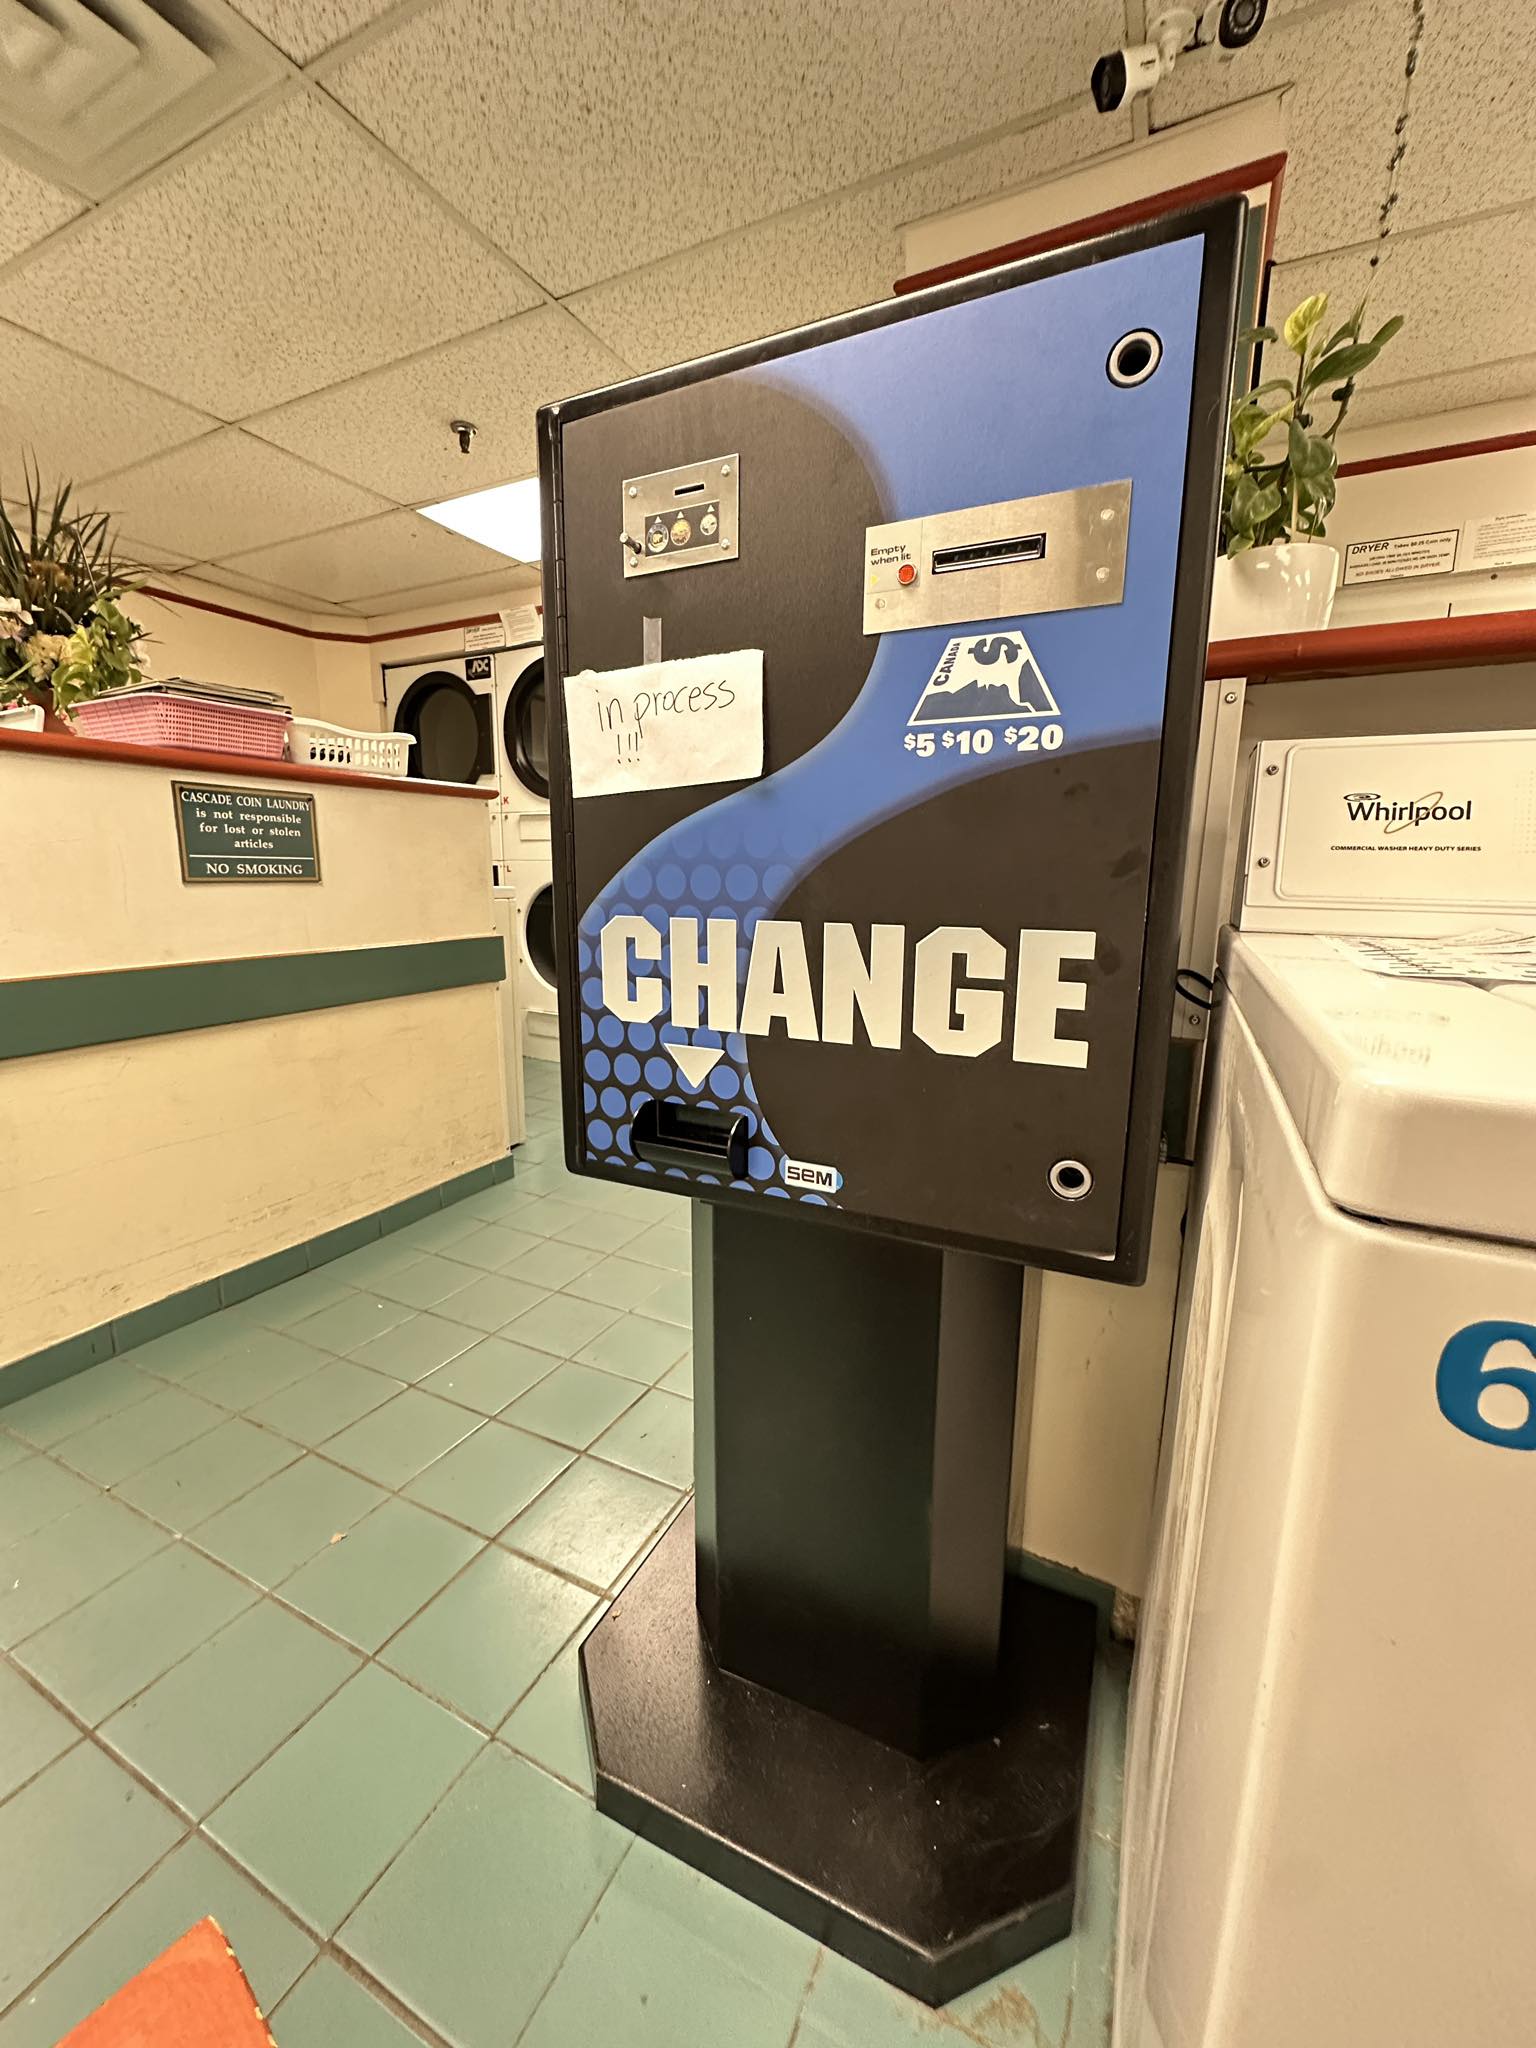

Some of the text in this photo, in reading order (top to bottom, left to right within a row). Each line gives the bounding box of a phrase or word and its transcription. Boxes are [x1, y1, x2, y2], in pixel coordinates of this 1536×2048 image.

[870, 544, 906, 556] Empty
[1351, 542, 1390, 555] DRYER
[870, 553, 912, 566] when lit
[933, 641, 961, 686] CANADA
[633, 680, 736, 739] process
[903, 724, 1064, 758] $5 $10 $20
[181, 791, 311, 812] CASCADE COIN LAUNDRY
[196, 808, 302, 824] is not responsible
[1346, 800, 1472, 827] Whirlpool
[199, 822, 301, 837] for lost or stolen
[234, 839, 274, 849] articles
[206, 863, 303, 875] NO SMOKING
[600, 915, 1097, 1070] CHANGE
[1435, 1320, 1536, 1451] 6
